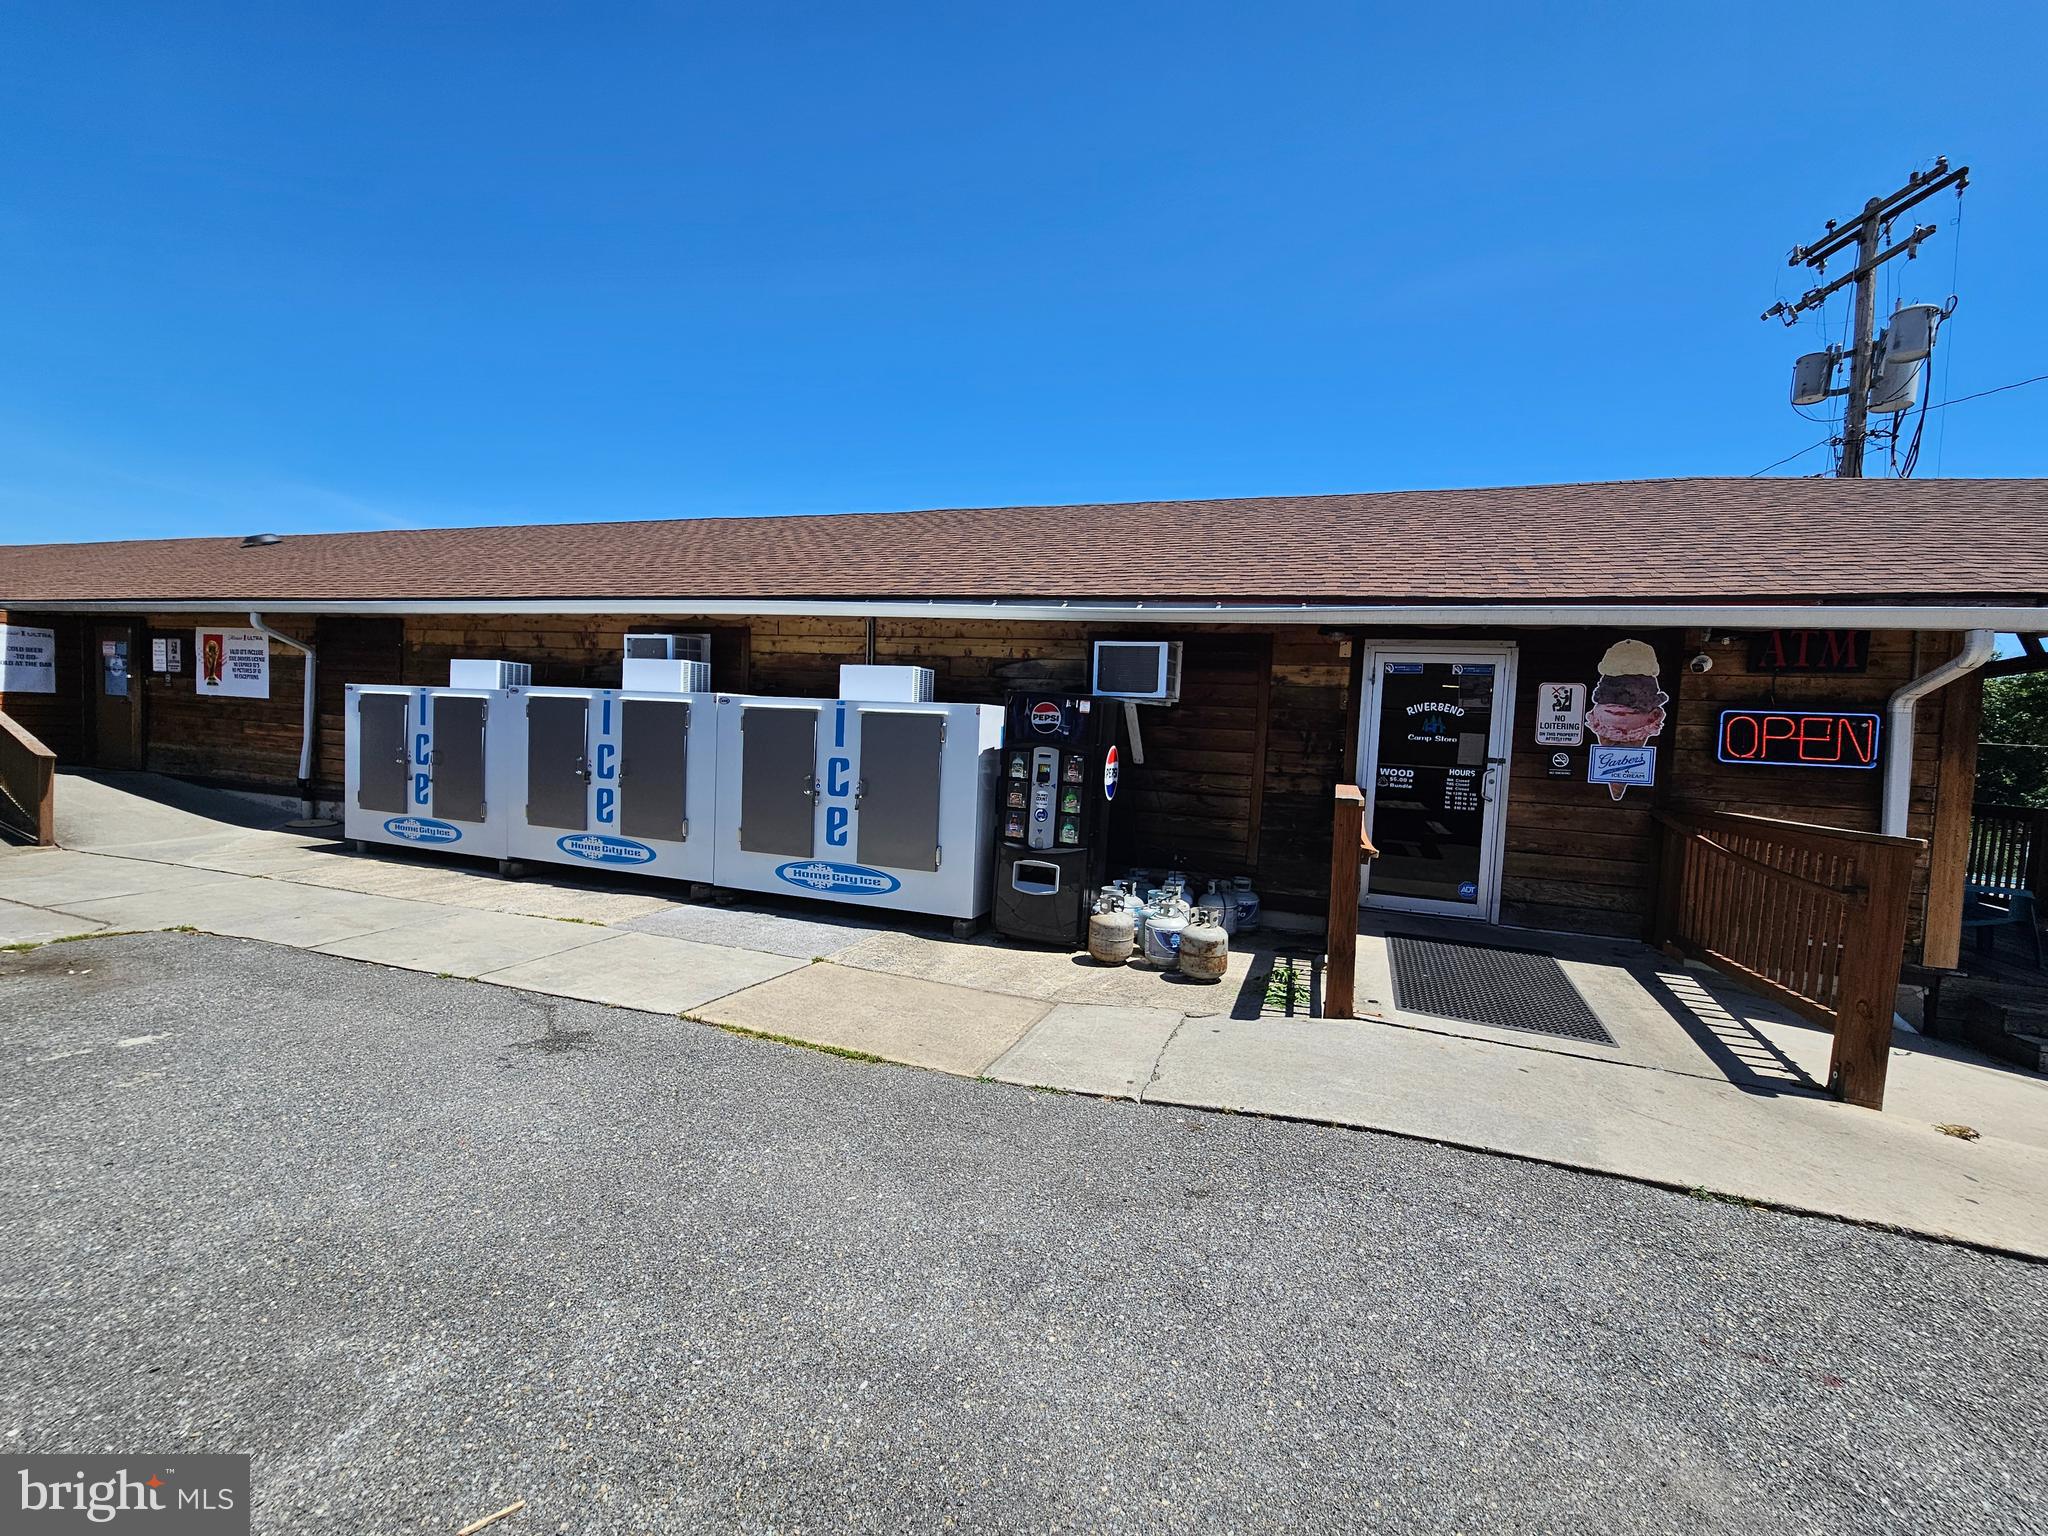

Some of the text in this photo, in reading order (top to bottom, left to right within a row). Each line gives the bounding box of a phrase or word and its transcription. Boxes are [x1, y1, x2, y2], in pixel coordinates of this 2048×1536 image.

[1759, 629, 1858, 668] ATM
[1406, 702, 1465, 717] RIVERBEND
[1033, 713, 1059, 722] PEPSI
[1540, 722, 1579, 730] LOITERING
[1407, 734, 1458, 743] Camp Store
[1727, 716, 1872, 762] OPEN
[1380, 768, 1414, 777] WOOD
[1449, 768, 1476, 777] HOURS
[394, 824, 451, 837] Home City Ice
[571, 841, 642, 857] Home City Ice
[793, 868, 882, 887] Home City Ice
